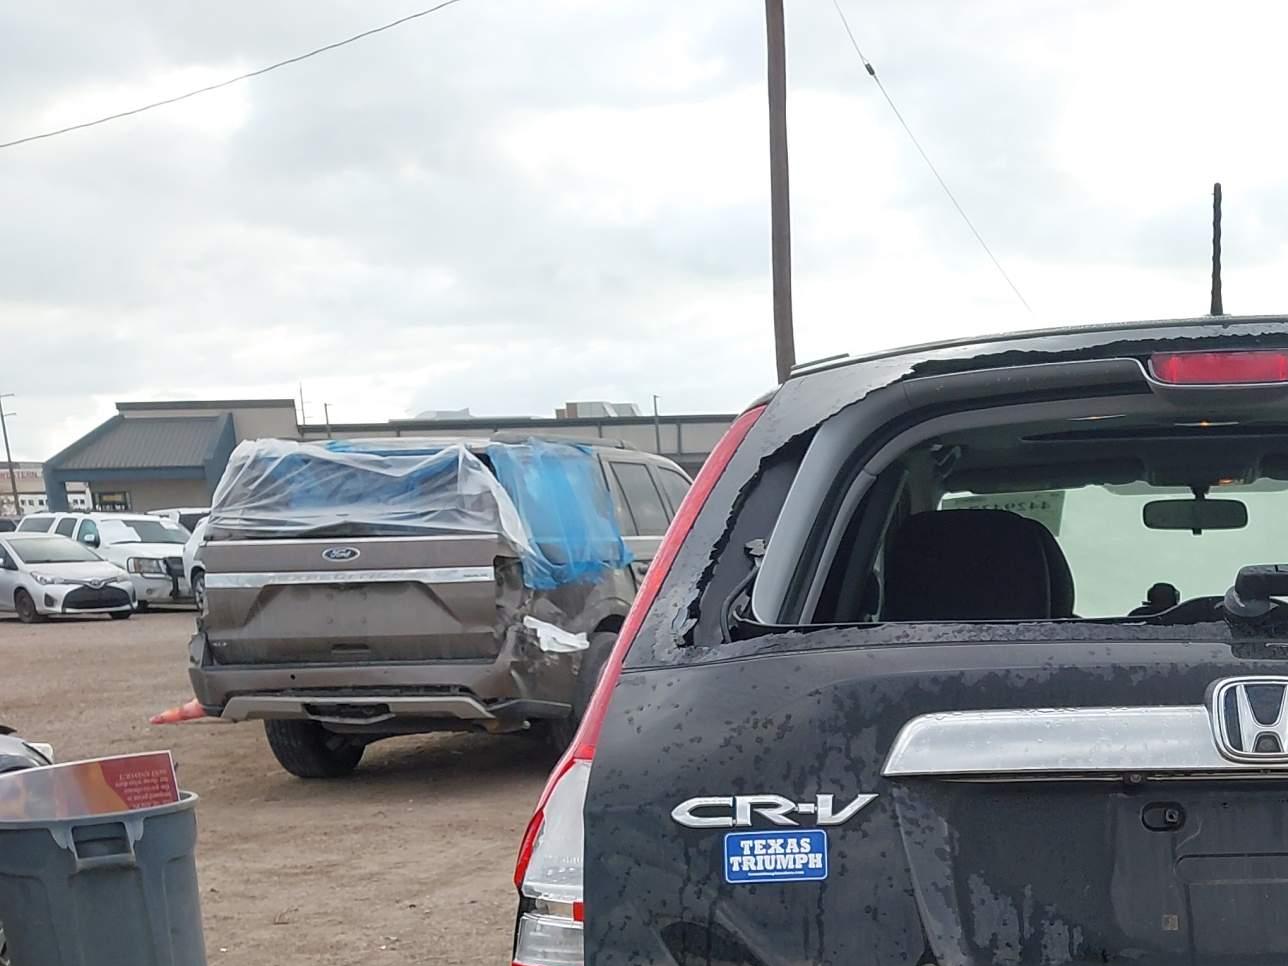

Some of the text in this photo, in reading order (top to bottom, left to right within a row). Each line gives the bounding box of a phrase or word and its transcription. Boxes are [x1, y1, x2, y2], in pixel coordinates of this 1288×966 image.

[671, 793, 879, 828] CR-V
[740, 838, 811, 855] TEXAS
[729, 853, 823, 872] TRIUMPH
